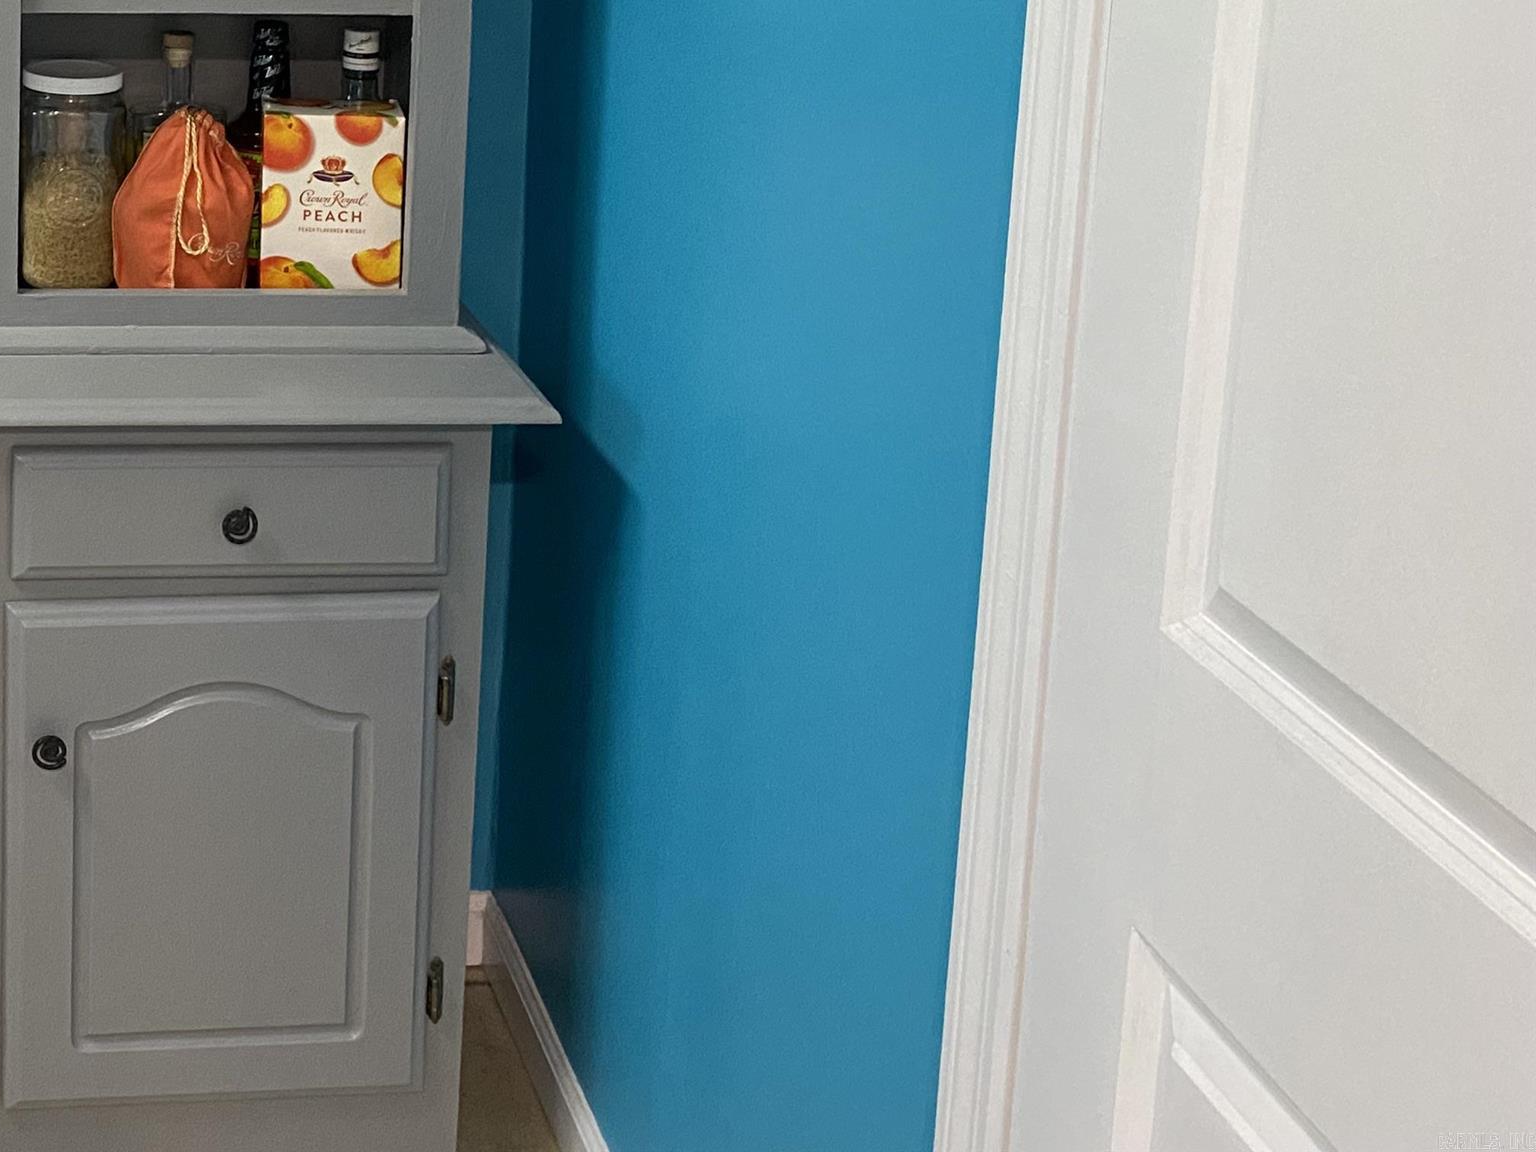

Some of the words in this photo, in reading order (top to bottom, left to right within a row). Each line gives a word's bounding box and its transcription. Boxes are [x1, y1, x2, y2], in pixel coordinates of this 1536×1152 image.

[299, 189, 332, 207] Crown
[329, 190, 368, 208] Royal
[303, 209, 362, 223] PEACH
